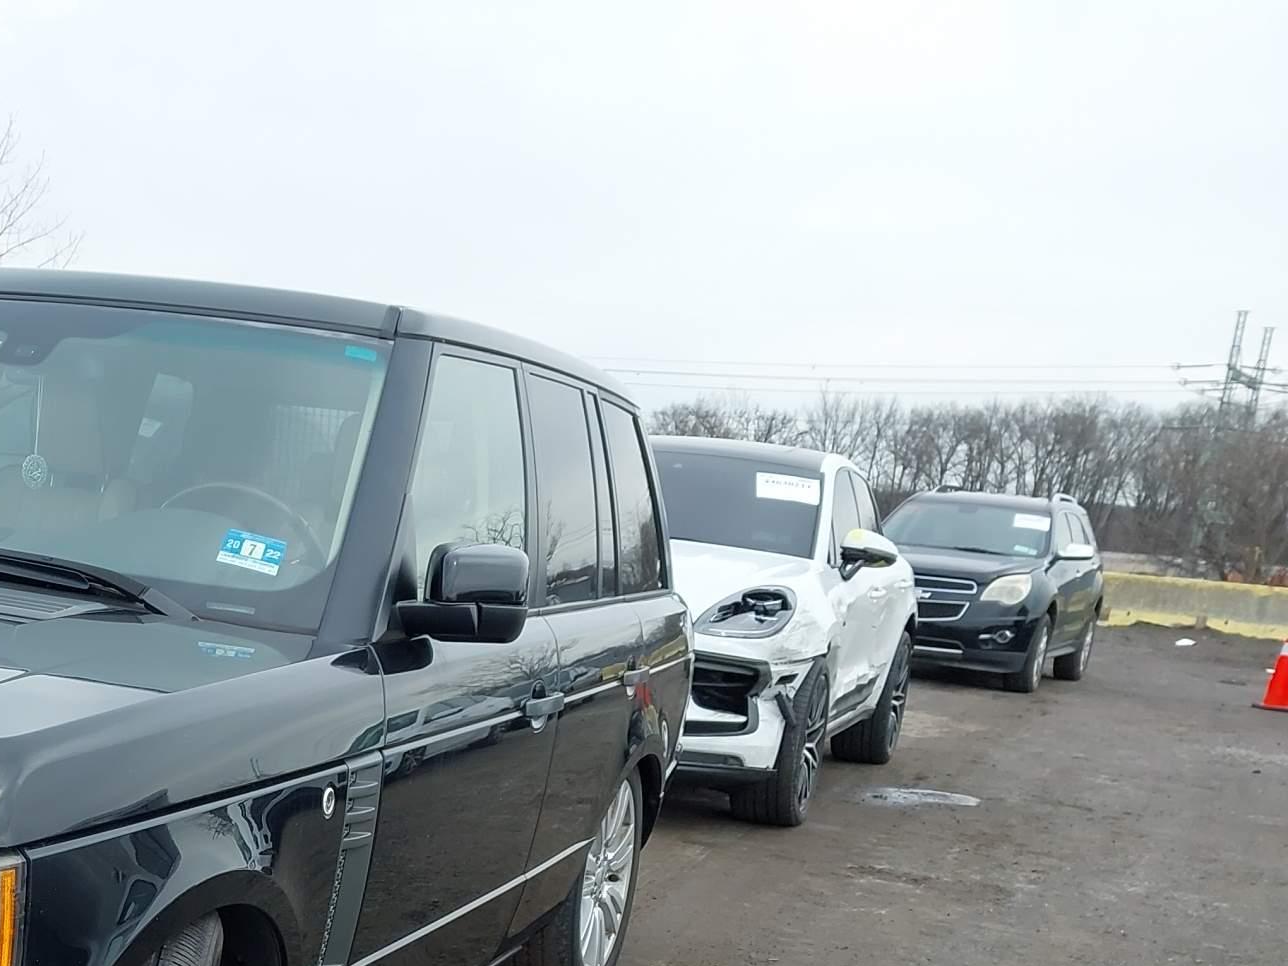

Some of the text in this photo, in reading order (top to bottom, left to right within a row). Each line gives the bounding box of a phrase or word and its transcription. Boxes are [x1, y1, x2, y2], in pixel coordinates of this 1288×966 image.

[226, 539, 281, 560] 20 7 22
